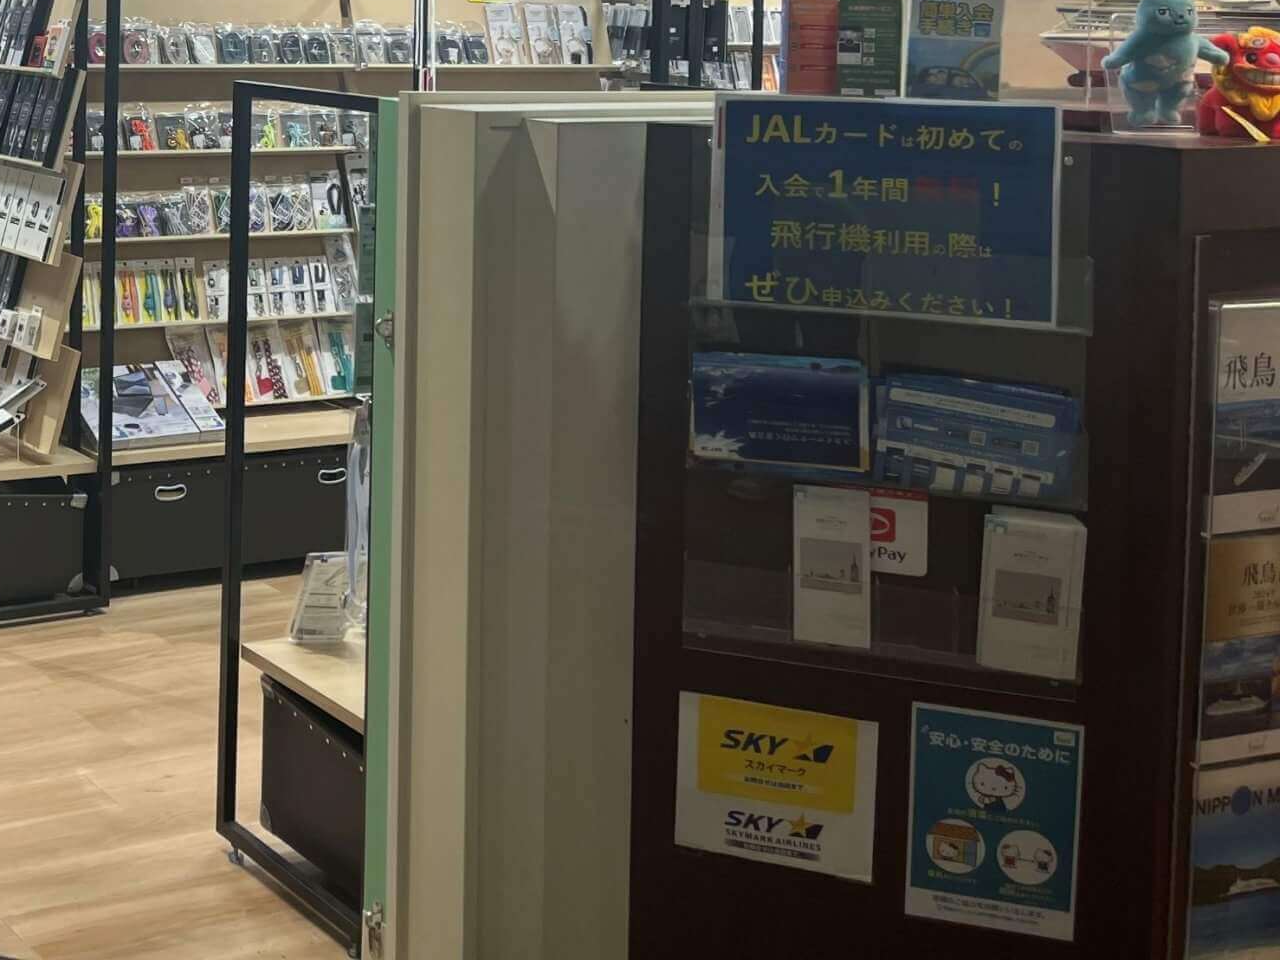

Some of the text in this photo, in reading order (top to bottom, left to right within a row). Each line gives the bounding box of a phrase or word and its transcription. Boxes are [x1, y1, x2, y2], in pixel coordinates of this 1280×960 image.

[745, 113, 1024, 151] JALカードは初めての
[770, 219, 992, 259] 飛行機利用の際は
[720, 728, 789, 755] SKY
[928, 730, 1072, 765] 安心・安全のために
[744, 759, 807, 776] スカイマーク
[724, 810, 785, 833] SKY
